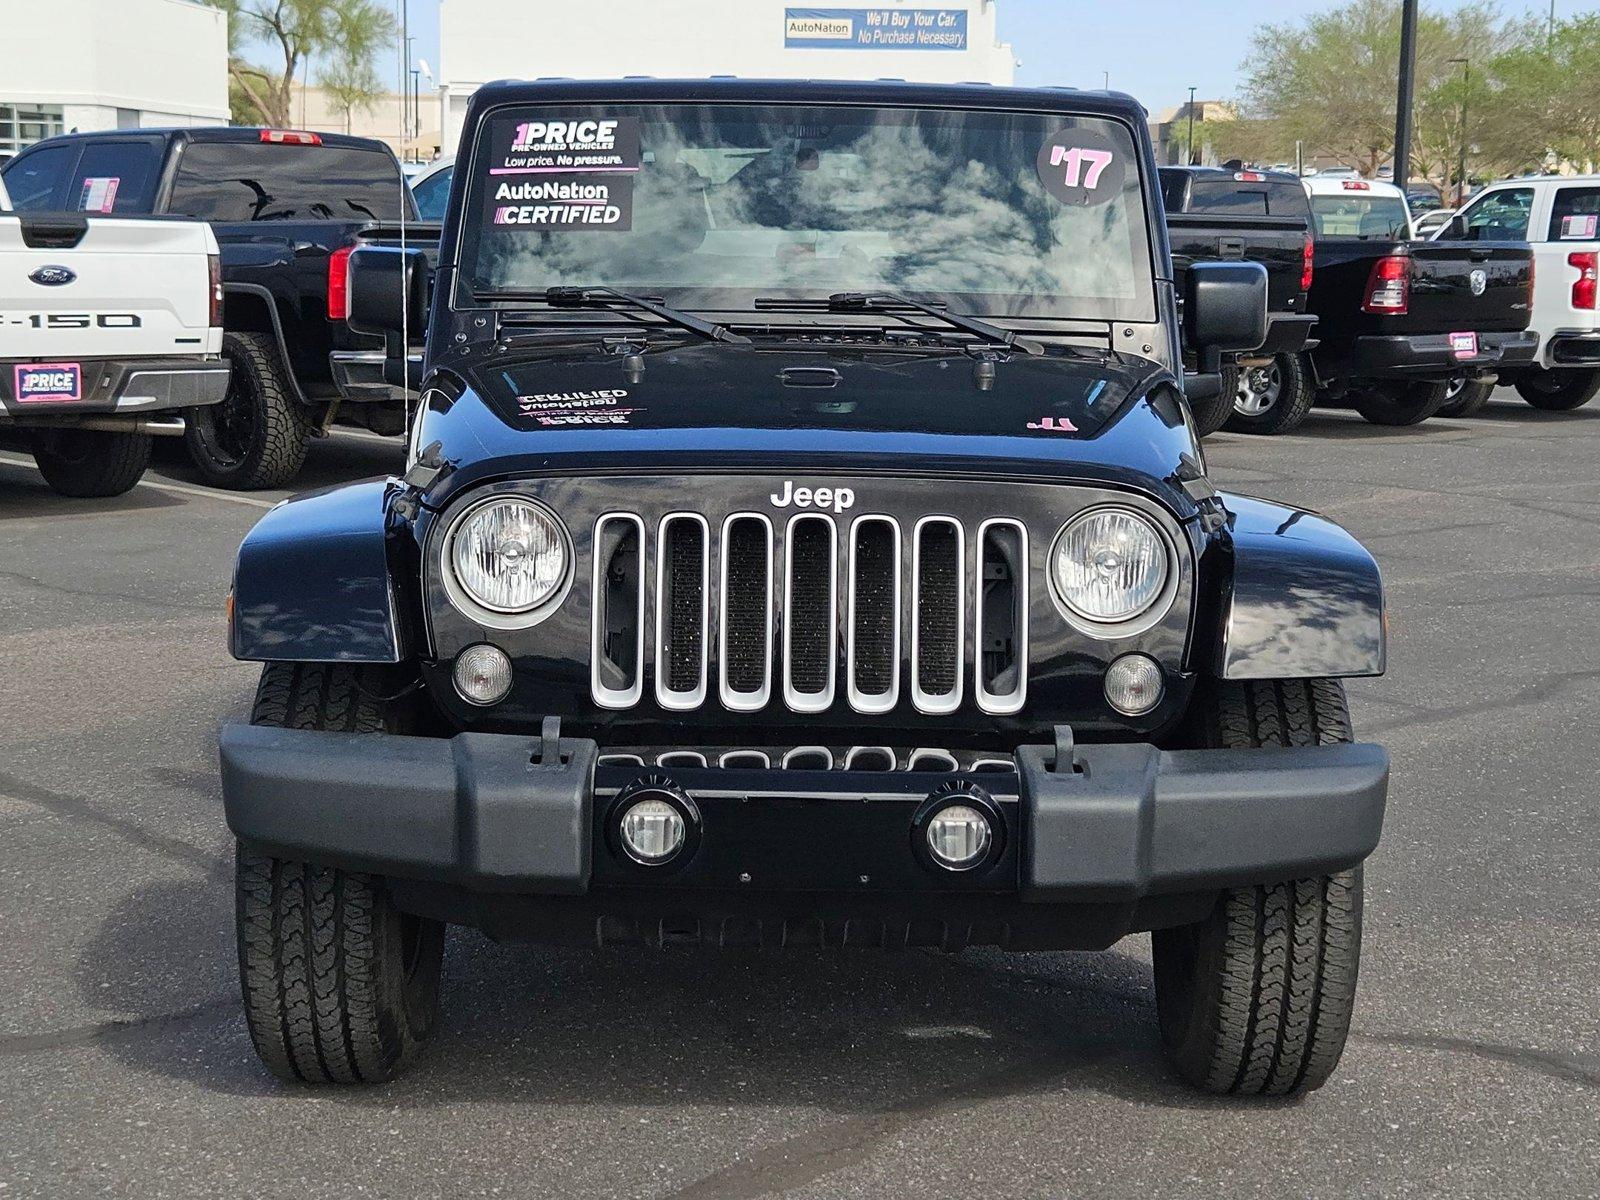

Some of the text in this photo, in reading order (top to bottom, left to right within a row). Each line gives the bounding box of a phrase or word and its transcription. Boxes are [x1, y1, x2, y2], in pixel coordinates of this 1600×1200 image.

[789, 23, 848, 33] AutoNation
[866, 12, 957, 28] We'll Buy Your Car.
[858, 30, 964, 47] No Purchase Necessary.
[513, 121, 618, 145] 1PRICE
[511, 142, 614, 152] PRE-OWNED VEHICLES
[504, 155, 623, 167] Low price. No pressure.
[1049, 145, 1113, 189] '17
[495, 182, 609, 200] AutoNation
[502, 206, 621, 224] CERTIFIED
[0, 314, 142, 328] -150
[770, 481, 855, 513] Jeep
